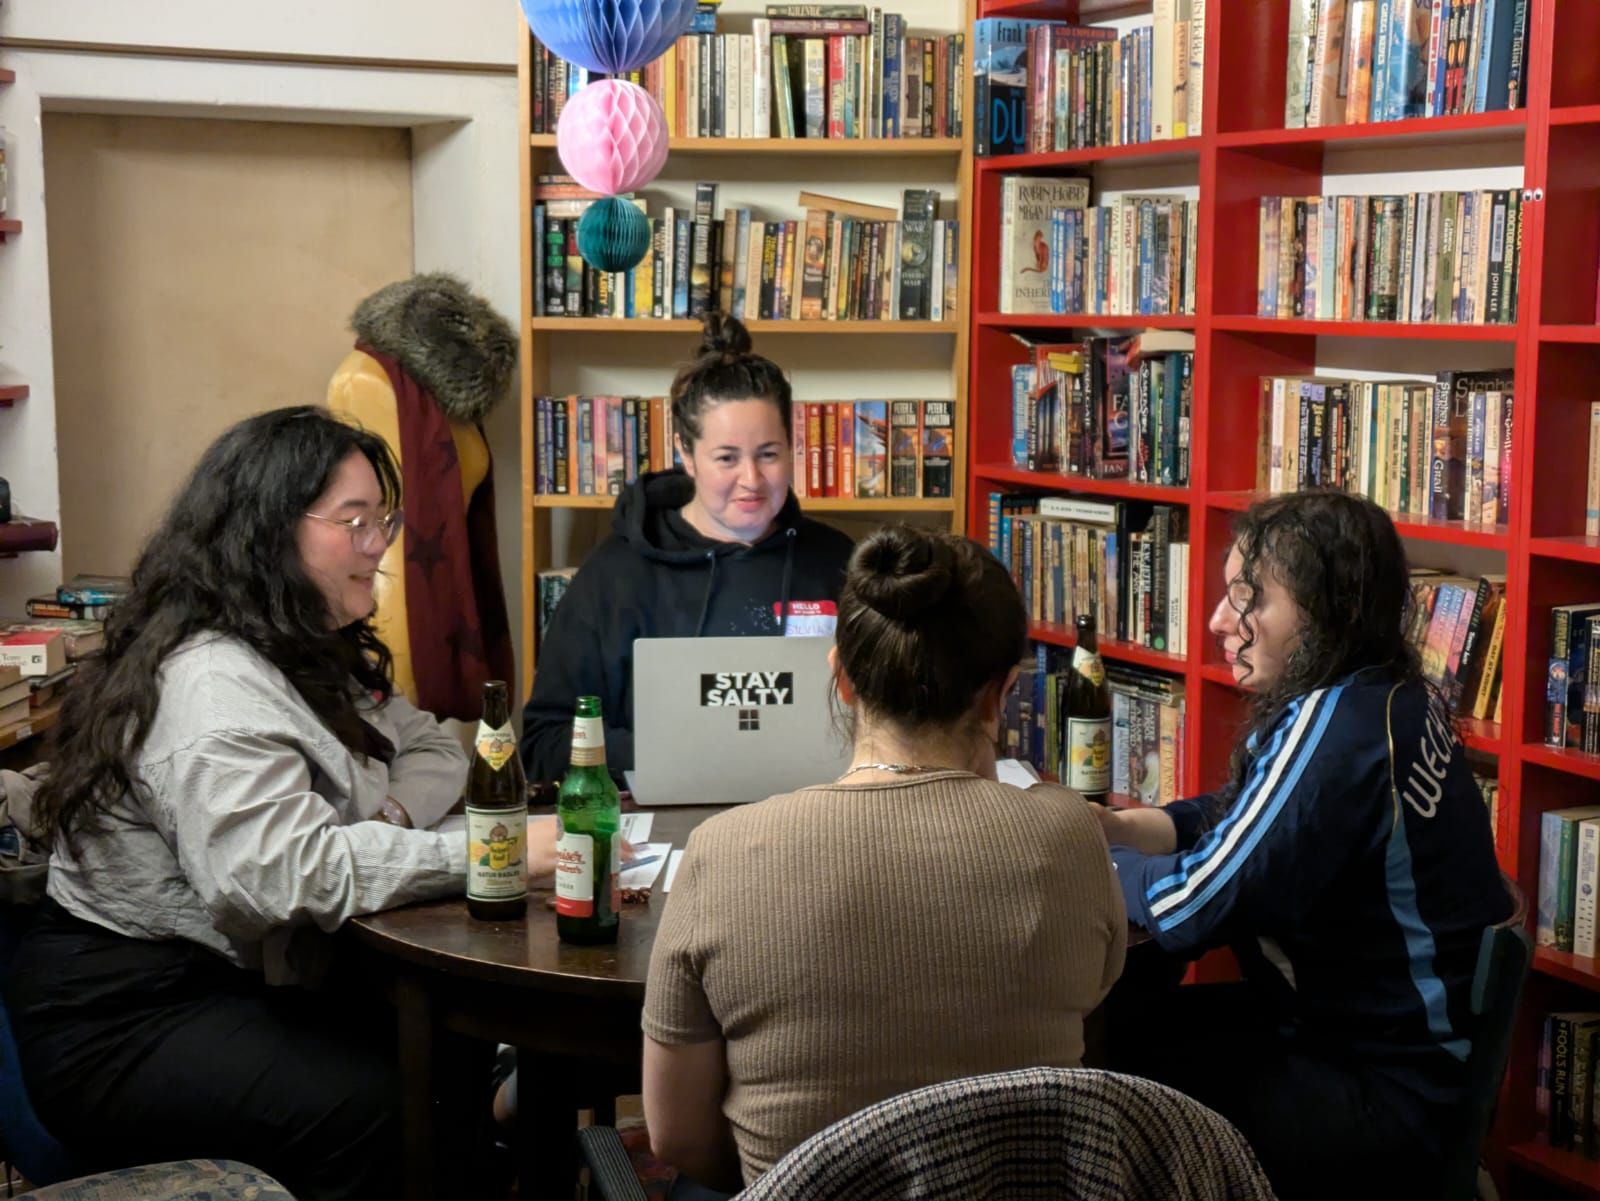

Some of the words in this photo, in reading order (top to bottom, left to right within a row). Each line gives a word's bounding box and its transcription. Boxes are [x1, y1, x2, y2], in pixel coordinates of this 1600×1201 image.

[997, 21, 1022, 43] Frank
[1506, 209, 1515, 242] DOCTOR
[1491, 272, 1499, 295] JOHN
[1490, 297, 1498, 313] LEE
[1455, 378, 1513, 397] Stephe
[928, 402, 940, 413] PETER
[1439, 382, 1451, 427] Stephen
[1104, 463, 1124, 474] IAN
[715, 672, 781, 690] STAY
[707, 688, 789, 707] SALTY
[1402, 703, 1458, 818] WECH
[1556, 1029, 1568, 1067] FOOL'S
[1555, 1070, 1566, 1096] RUN
